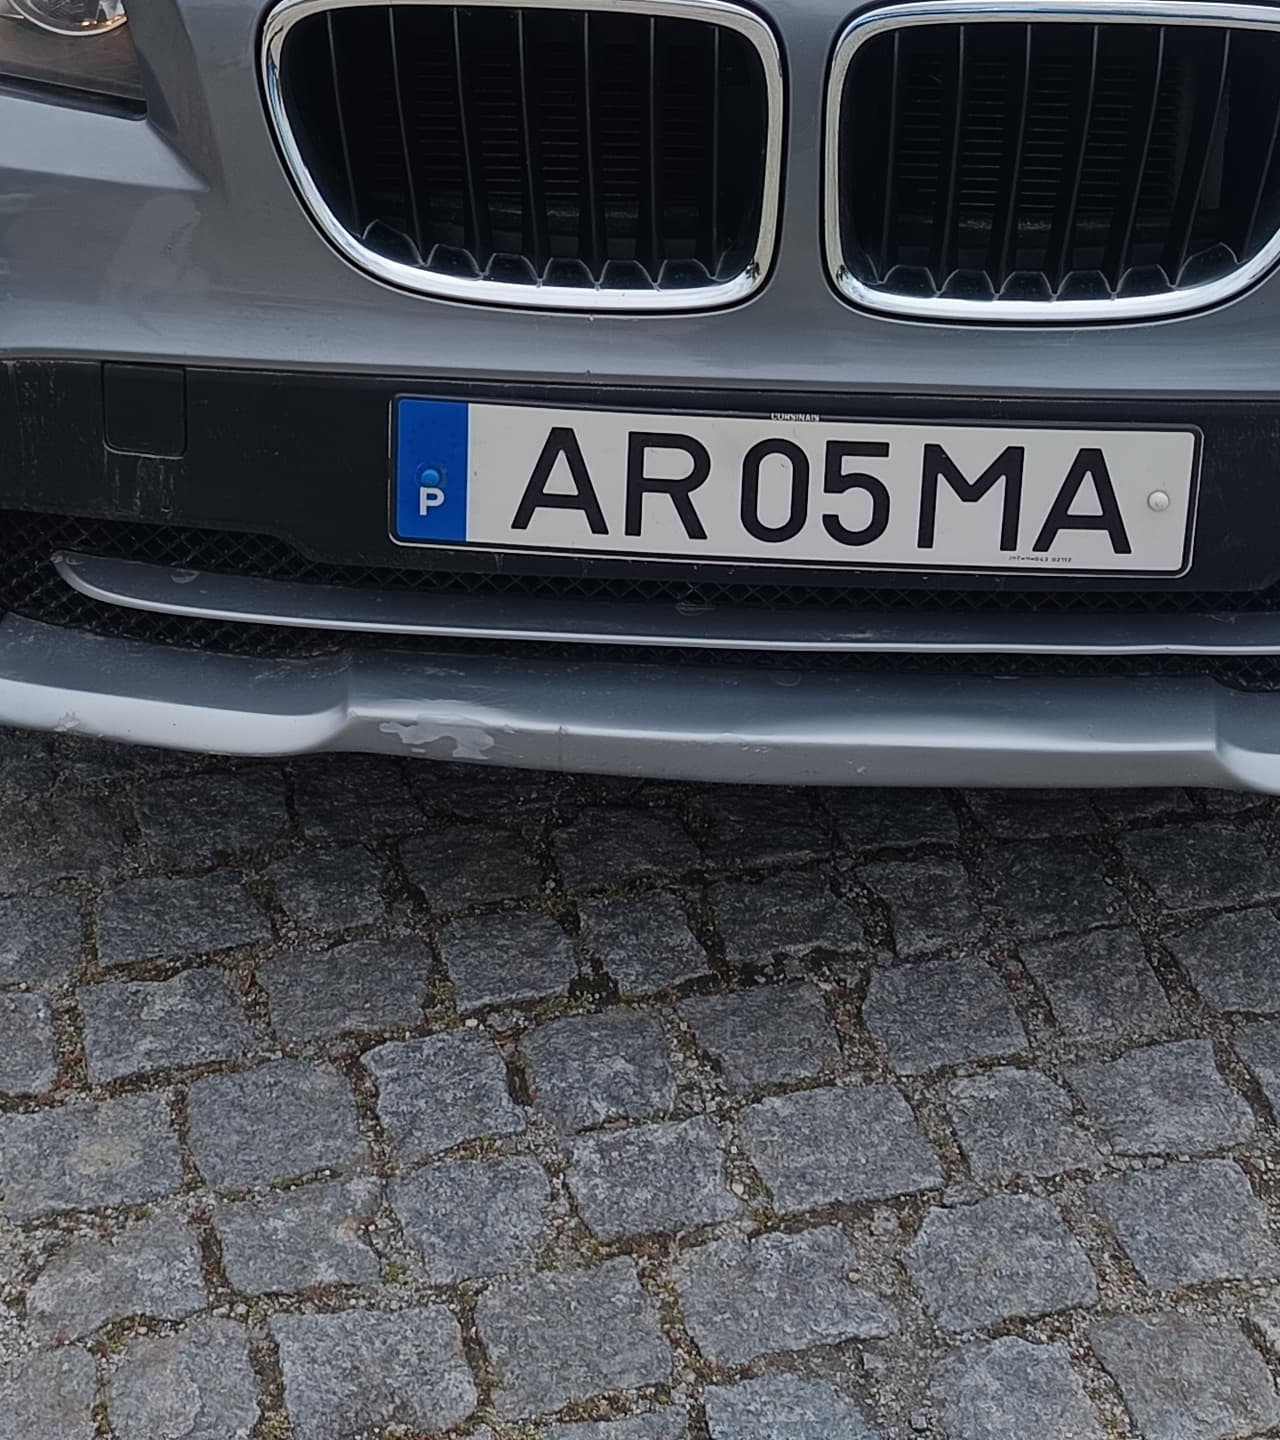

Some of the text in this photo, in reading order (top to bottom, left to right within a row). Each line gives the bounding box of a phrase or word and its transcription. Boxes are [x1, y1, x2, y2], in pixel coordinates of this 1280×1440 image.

[419, 486, 446, 517] P
[510, 426, 1132, 555] AR 05 MA
